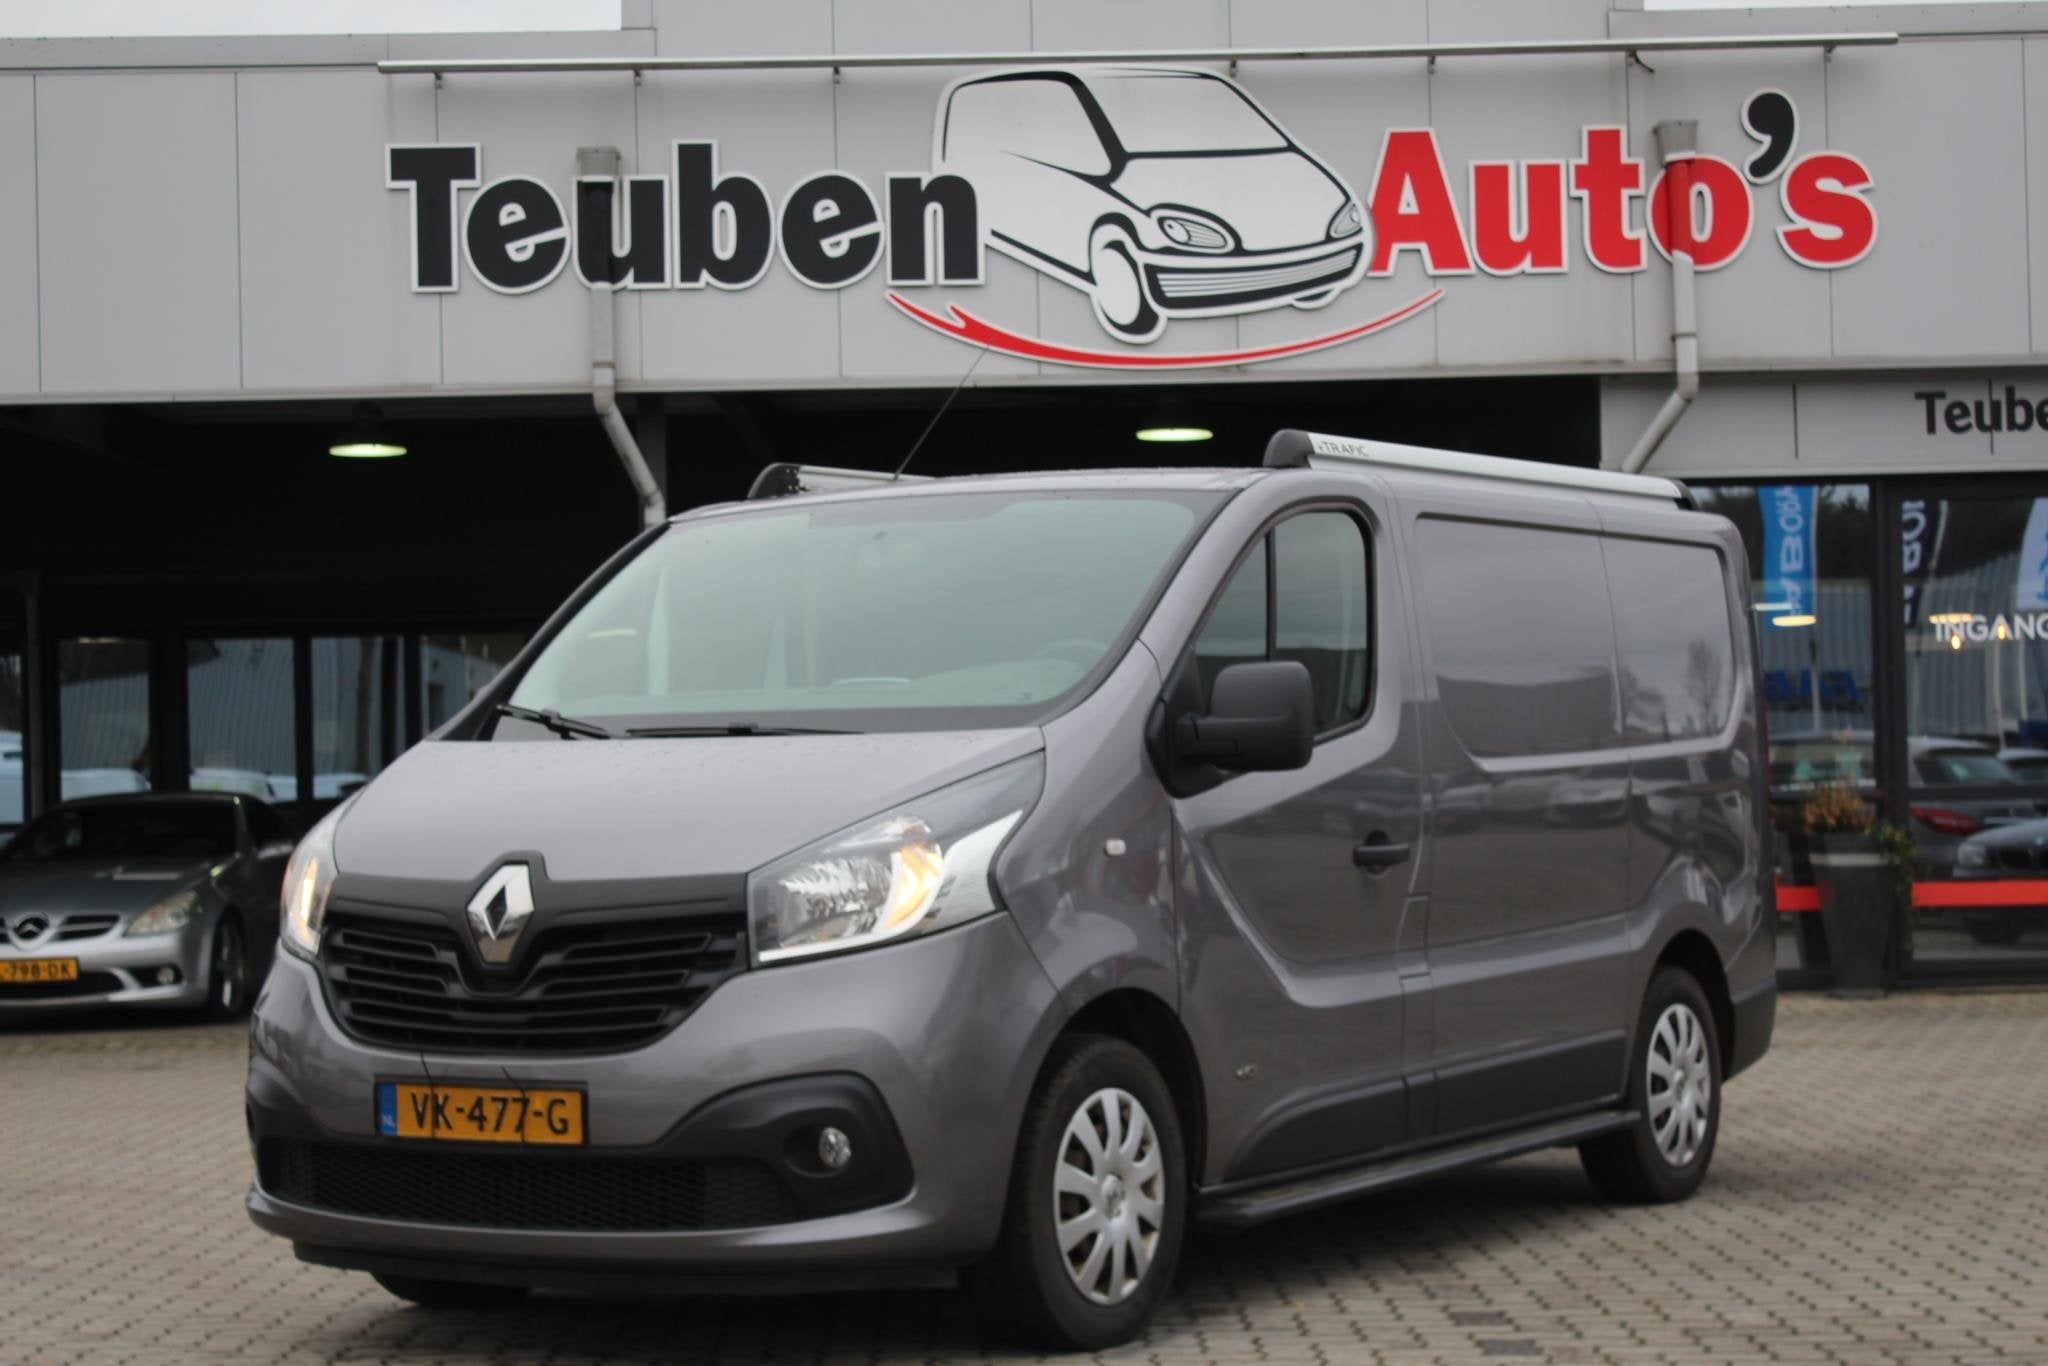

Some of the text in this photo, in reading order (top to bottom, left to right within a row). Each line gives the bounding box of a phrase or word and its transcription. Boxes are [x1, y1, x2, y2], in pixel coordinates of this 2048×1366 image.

[388, 90, 1876, 292] Teuben Auto's
[410, 1092, 569, 1136] VK-477-G
